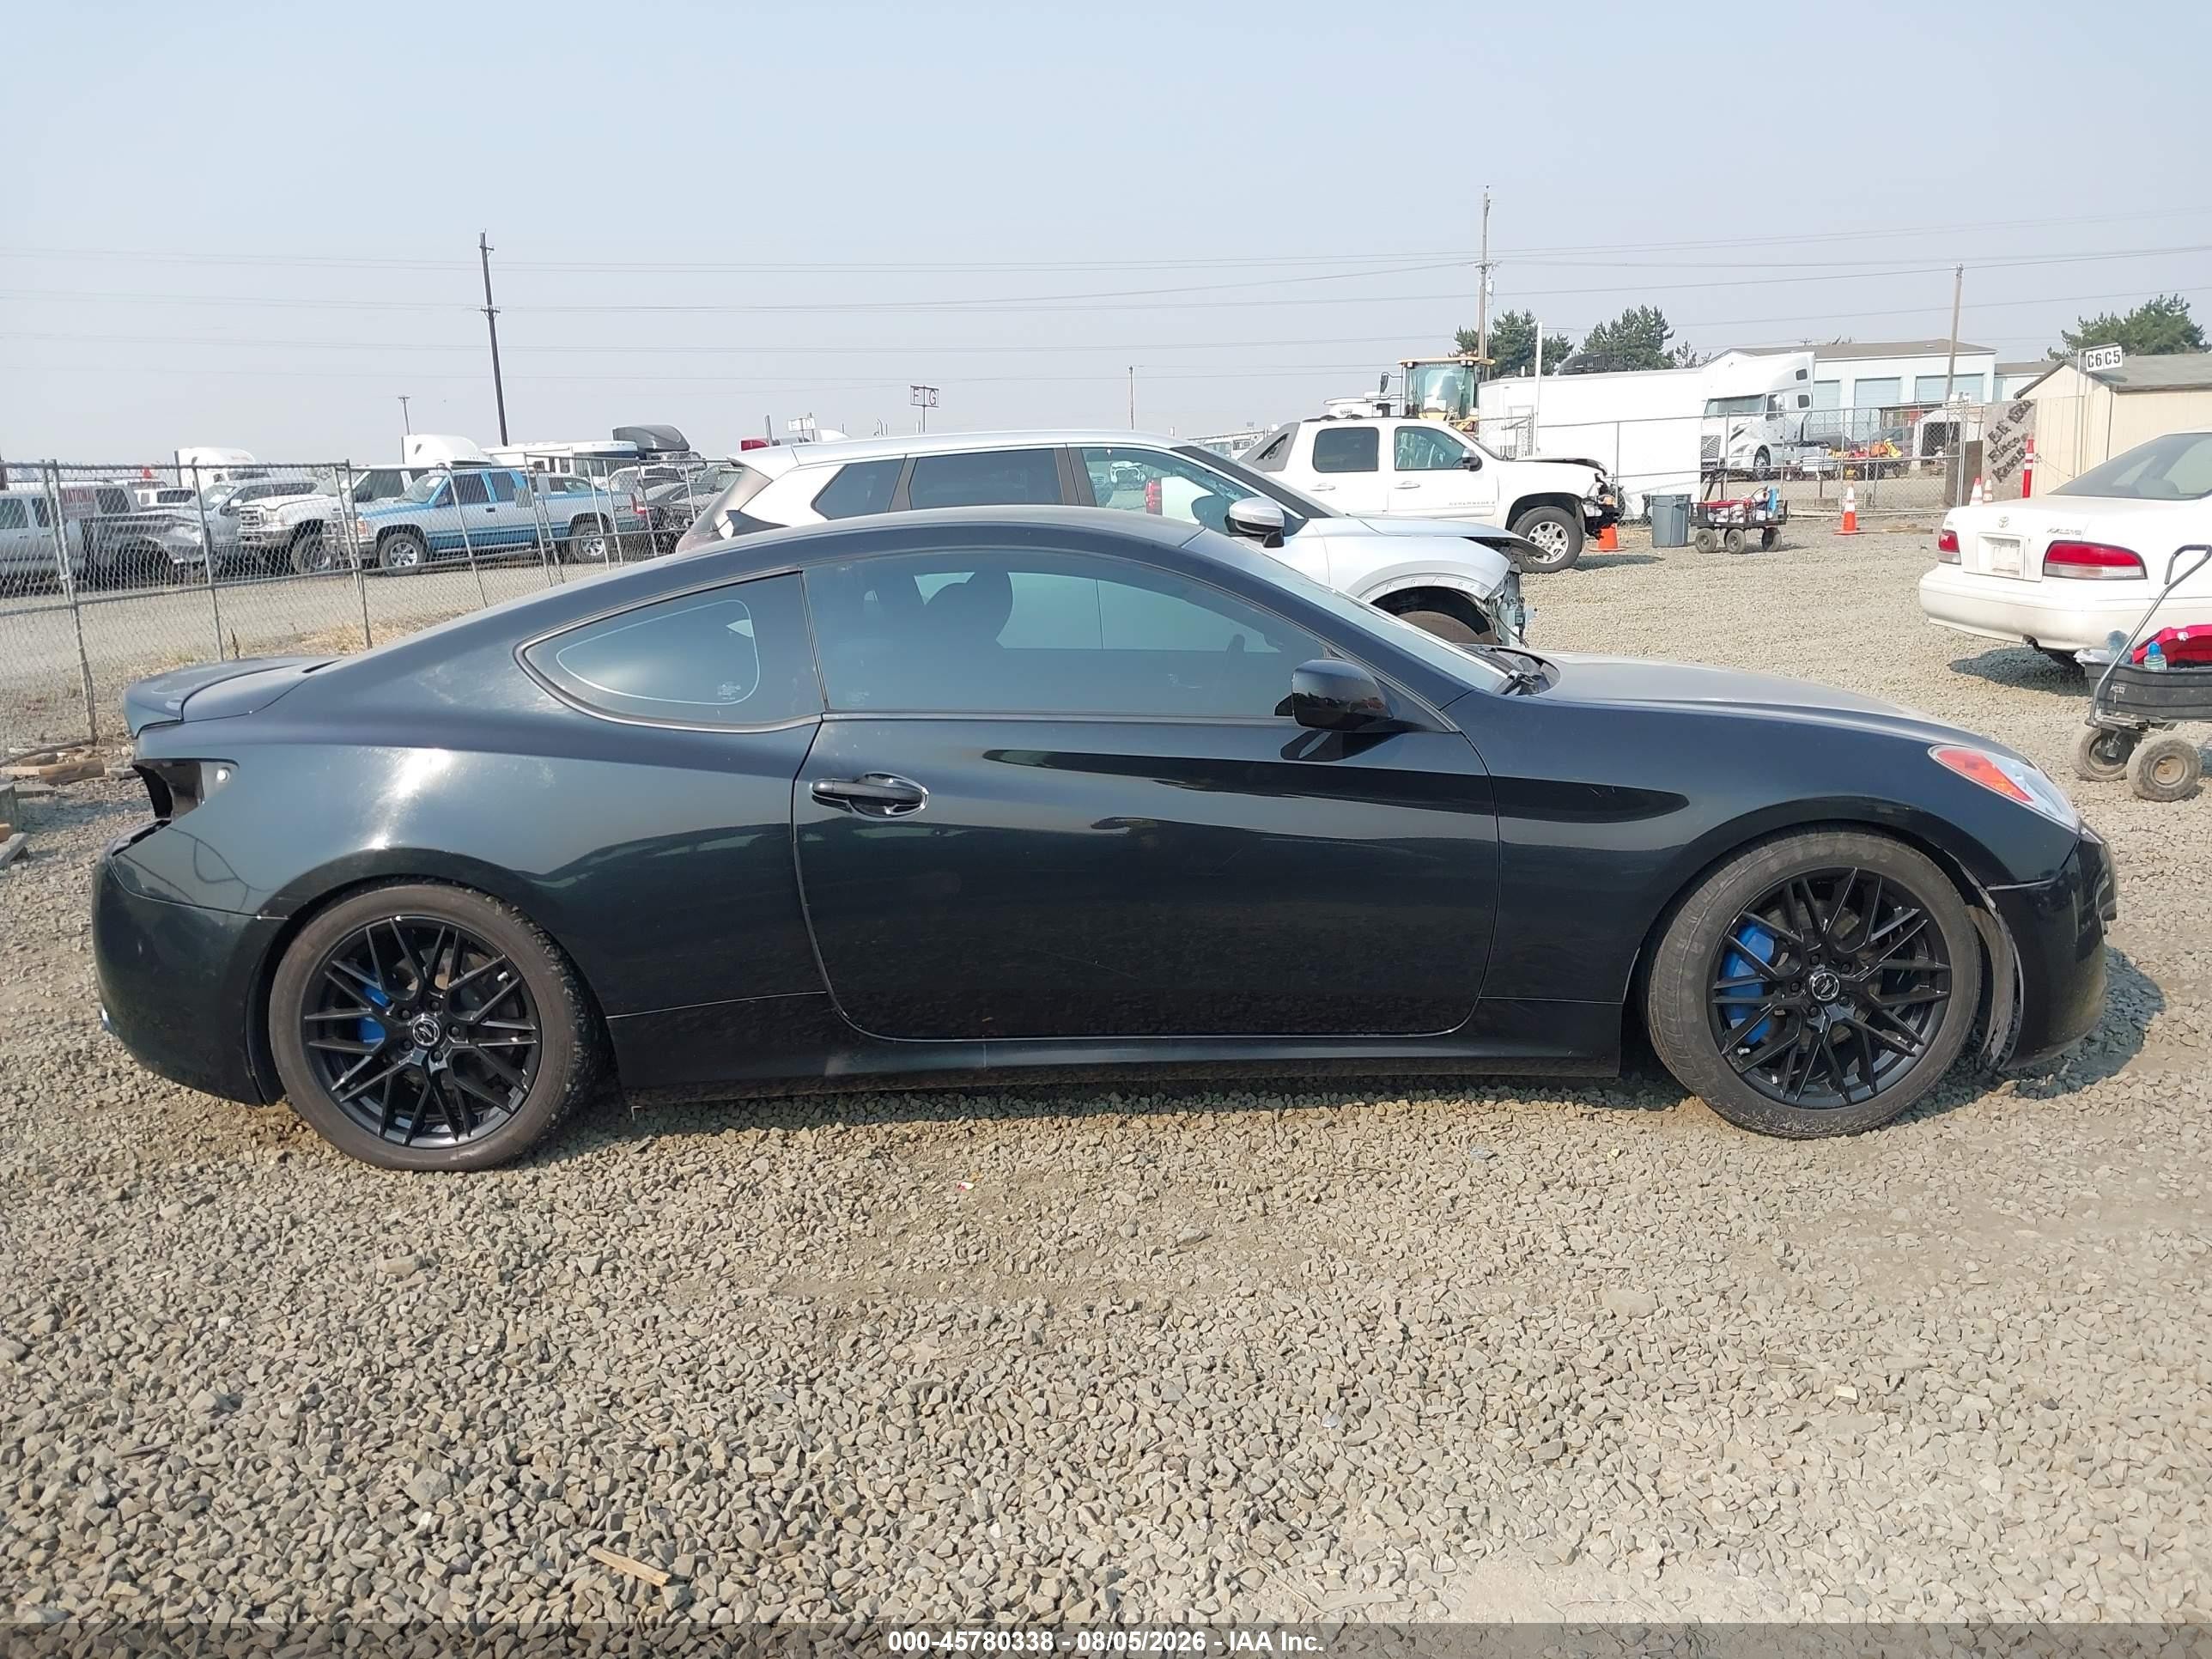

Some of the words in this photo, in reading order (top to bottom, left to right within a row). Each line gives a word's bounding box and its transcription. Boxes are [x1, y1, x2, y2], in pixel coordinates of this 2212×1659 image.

[2087, 353, 2102, 368] C6
[2105, 350, 2121, 365] C5
[913, 388, 920, 404] F
[929, 390, 937, 405] G
